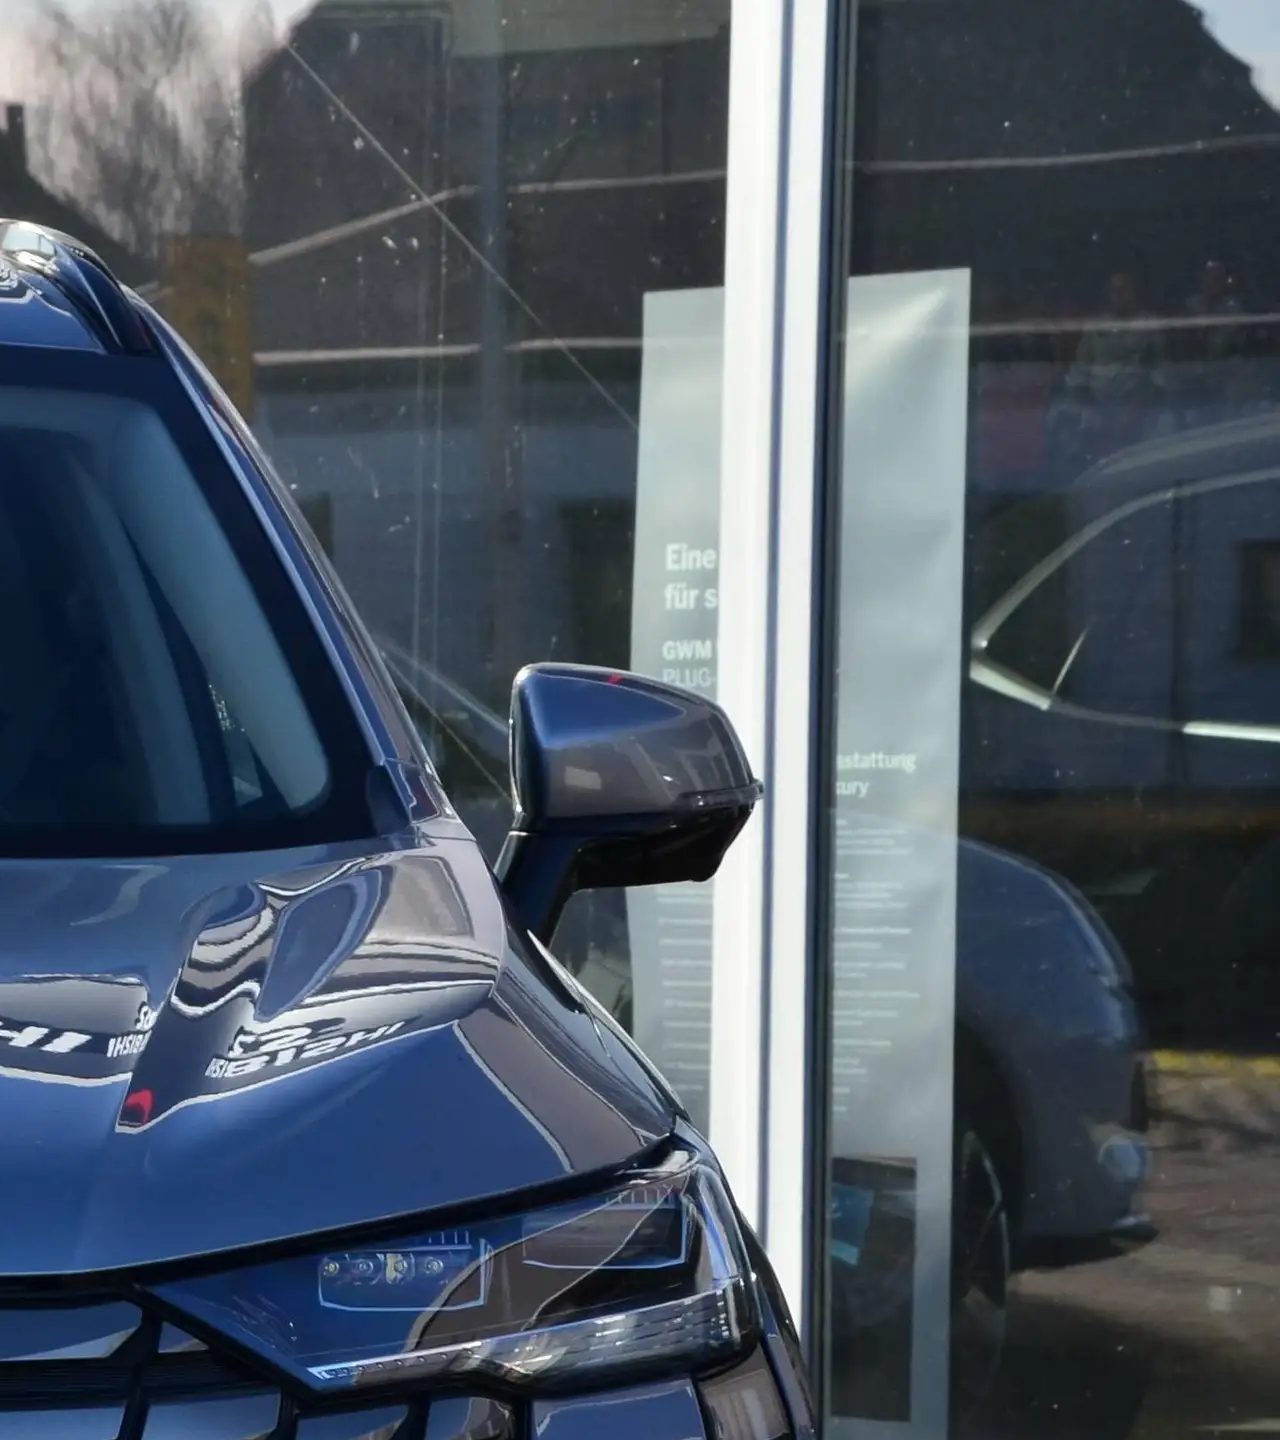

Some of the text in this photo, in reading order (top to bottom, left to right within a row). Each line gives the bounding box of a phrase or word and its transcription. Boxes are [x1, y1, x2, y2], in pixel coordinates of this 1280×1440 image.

[666, 543, 717, 570] Eine
[664, 582, 699, 610] für
[662, 640, 712, 661] GWM
